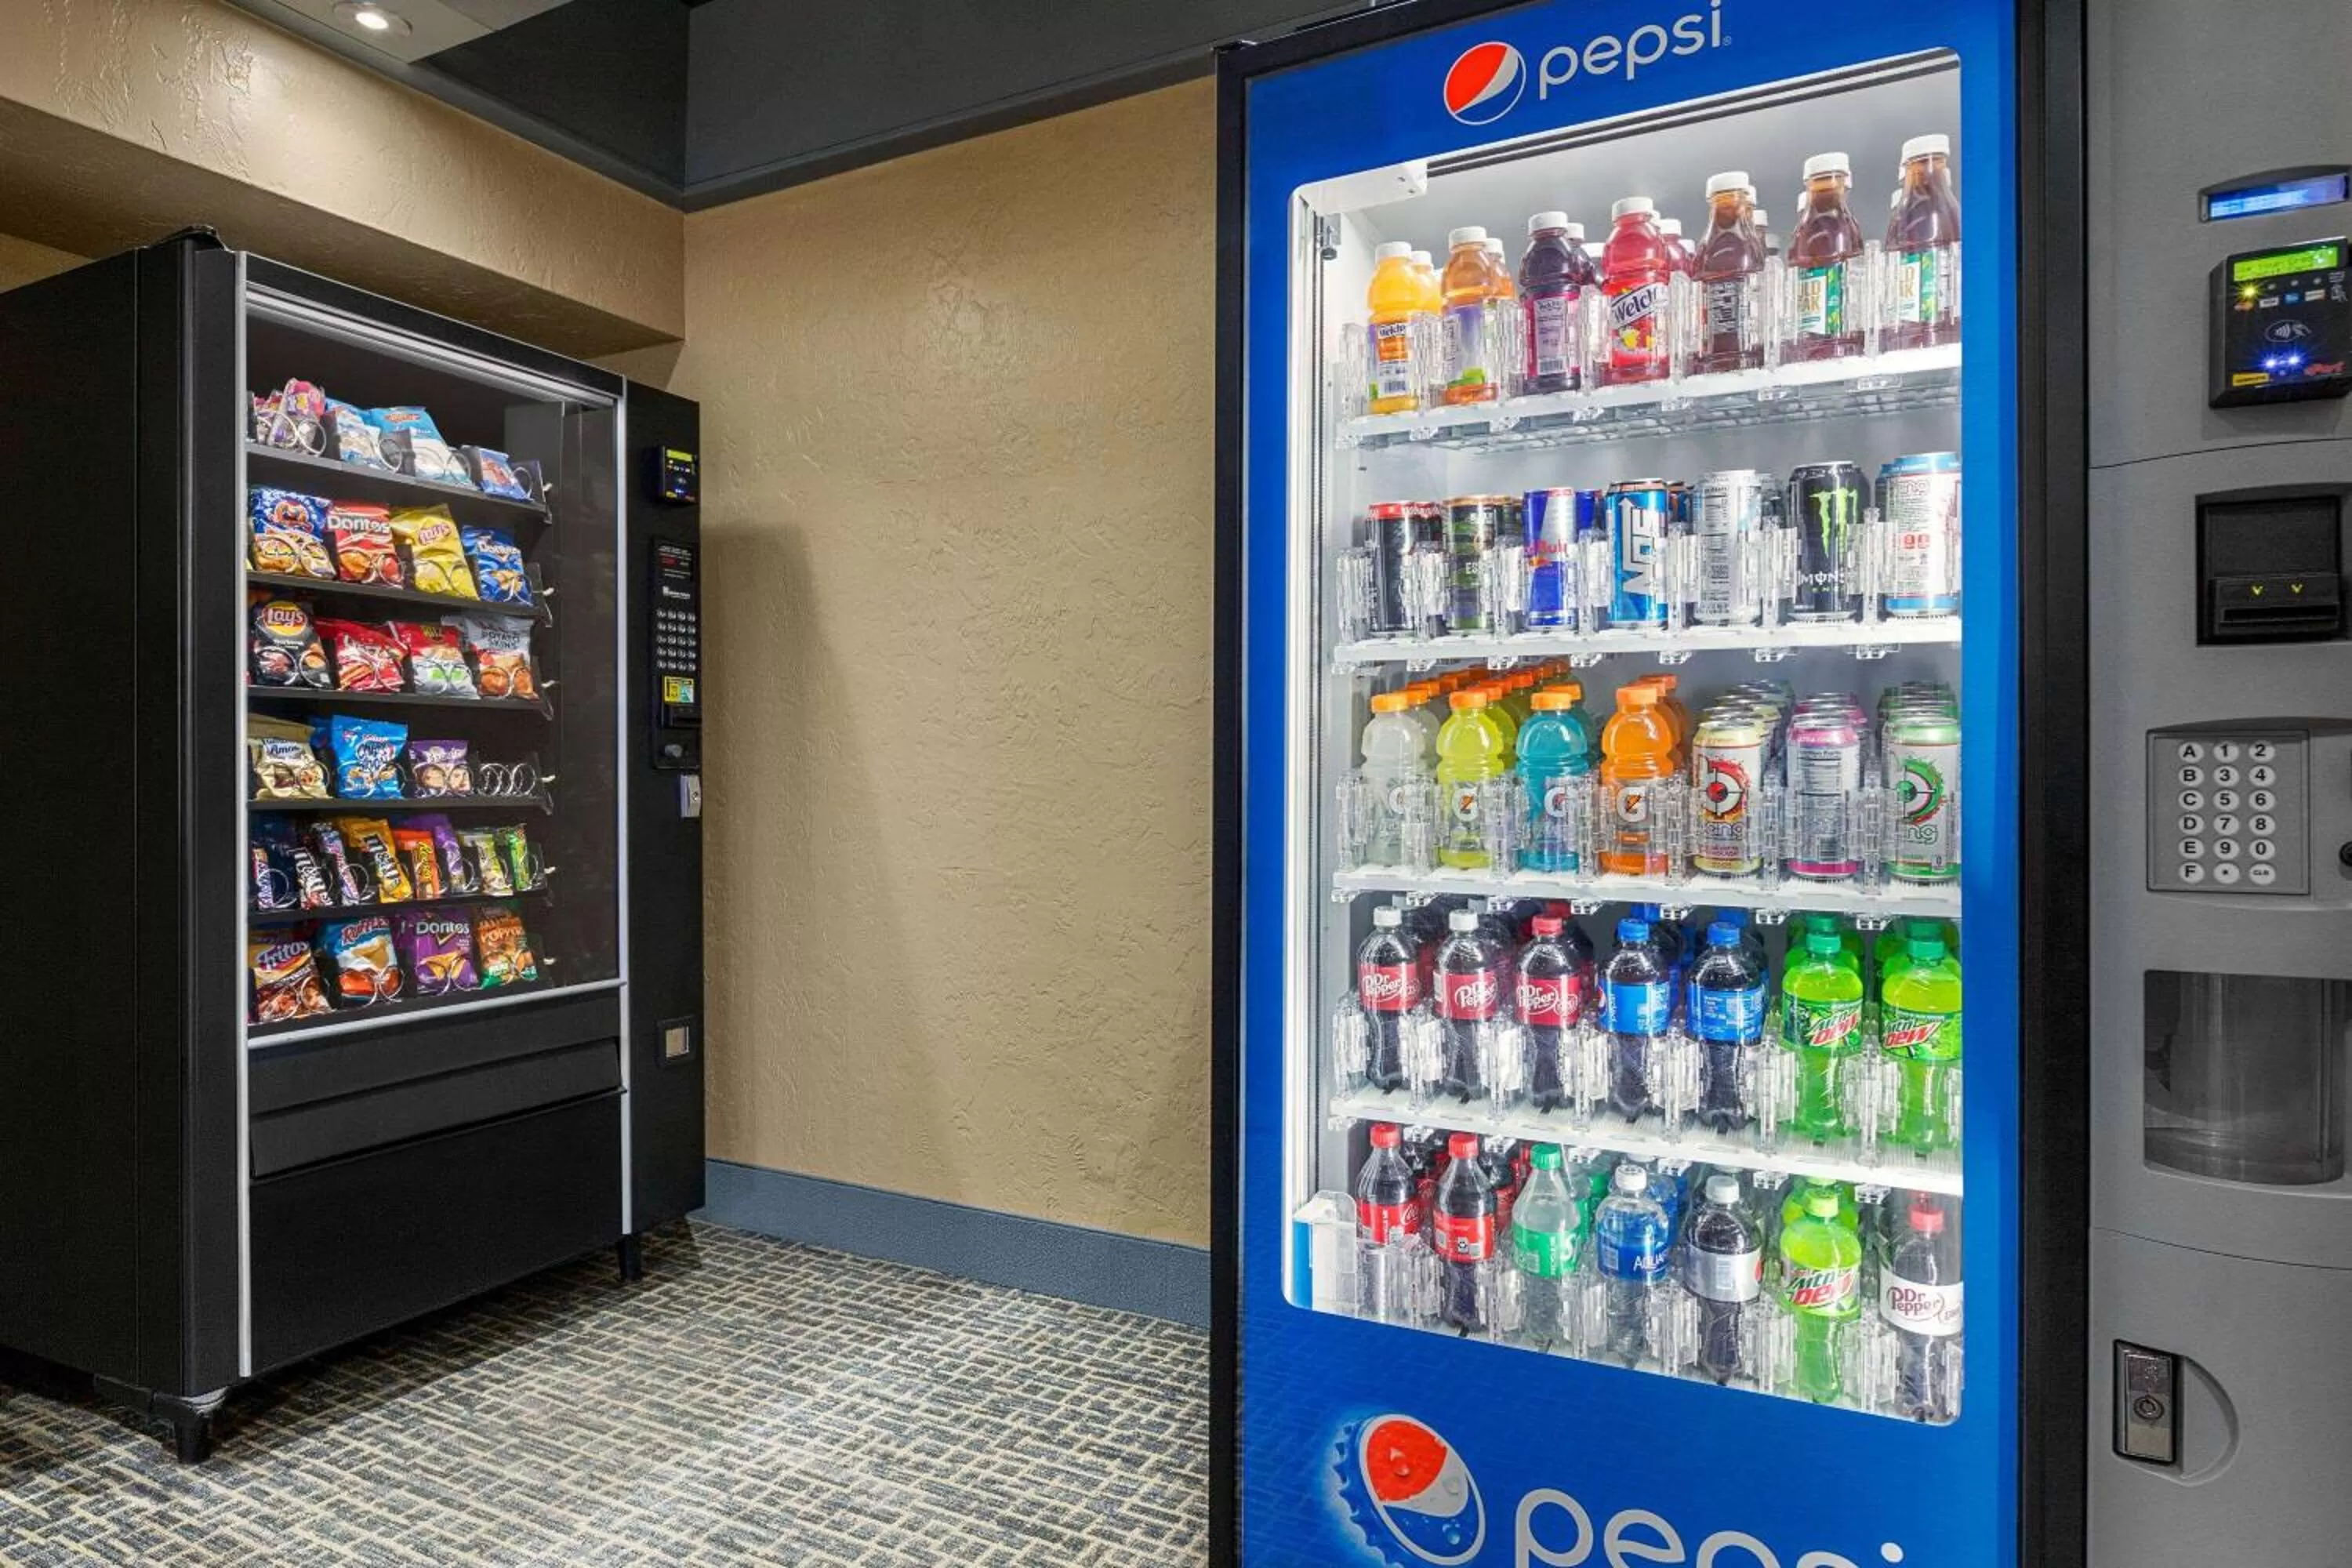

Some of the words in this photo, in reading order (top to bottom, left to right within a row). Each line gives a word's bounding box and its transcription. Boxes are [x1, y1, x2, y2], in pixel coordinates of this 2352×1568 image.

[1539, 0, 1722, 100] pepsi
[326, 514, 392, 535] Doritos
[2183, 746, 2196, 758] A
[2220, 745, 2228, 757] 1
[2254, 744, 2266, 757] 2
[2183, 769, 2196, 782] B
[2220, 769, 2230, 782] 3
[2255, 768, 2266, 781] 4
[2183, 793, 2197, 806] C
[2220, 793, 2230, 806] 5
[2255, 793, 2266, 806] 6
[2183, 818, 2197, 829] D
[2220, 818, 2230, 829] 7
[2255, 818, 2266, 830] 8
[2184, 842, 2196, 854] E
[2220, 842, 2230, 855] 9
[2255, 842, 2267, 855] 0
[2185, 866, 2196, 878] F
[416, 921, 470, 935] Doritos
[256, 941, 310, 970] Fritos
[1888, 1287, 1941, 1316] Pepper
[1904, 1288, 1926, 1303] Dr
